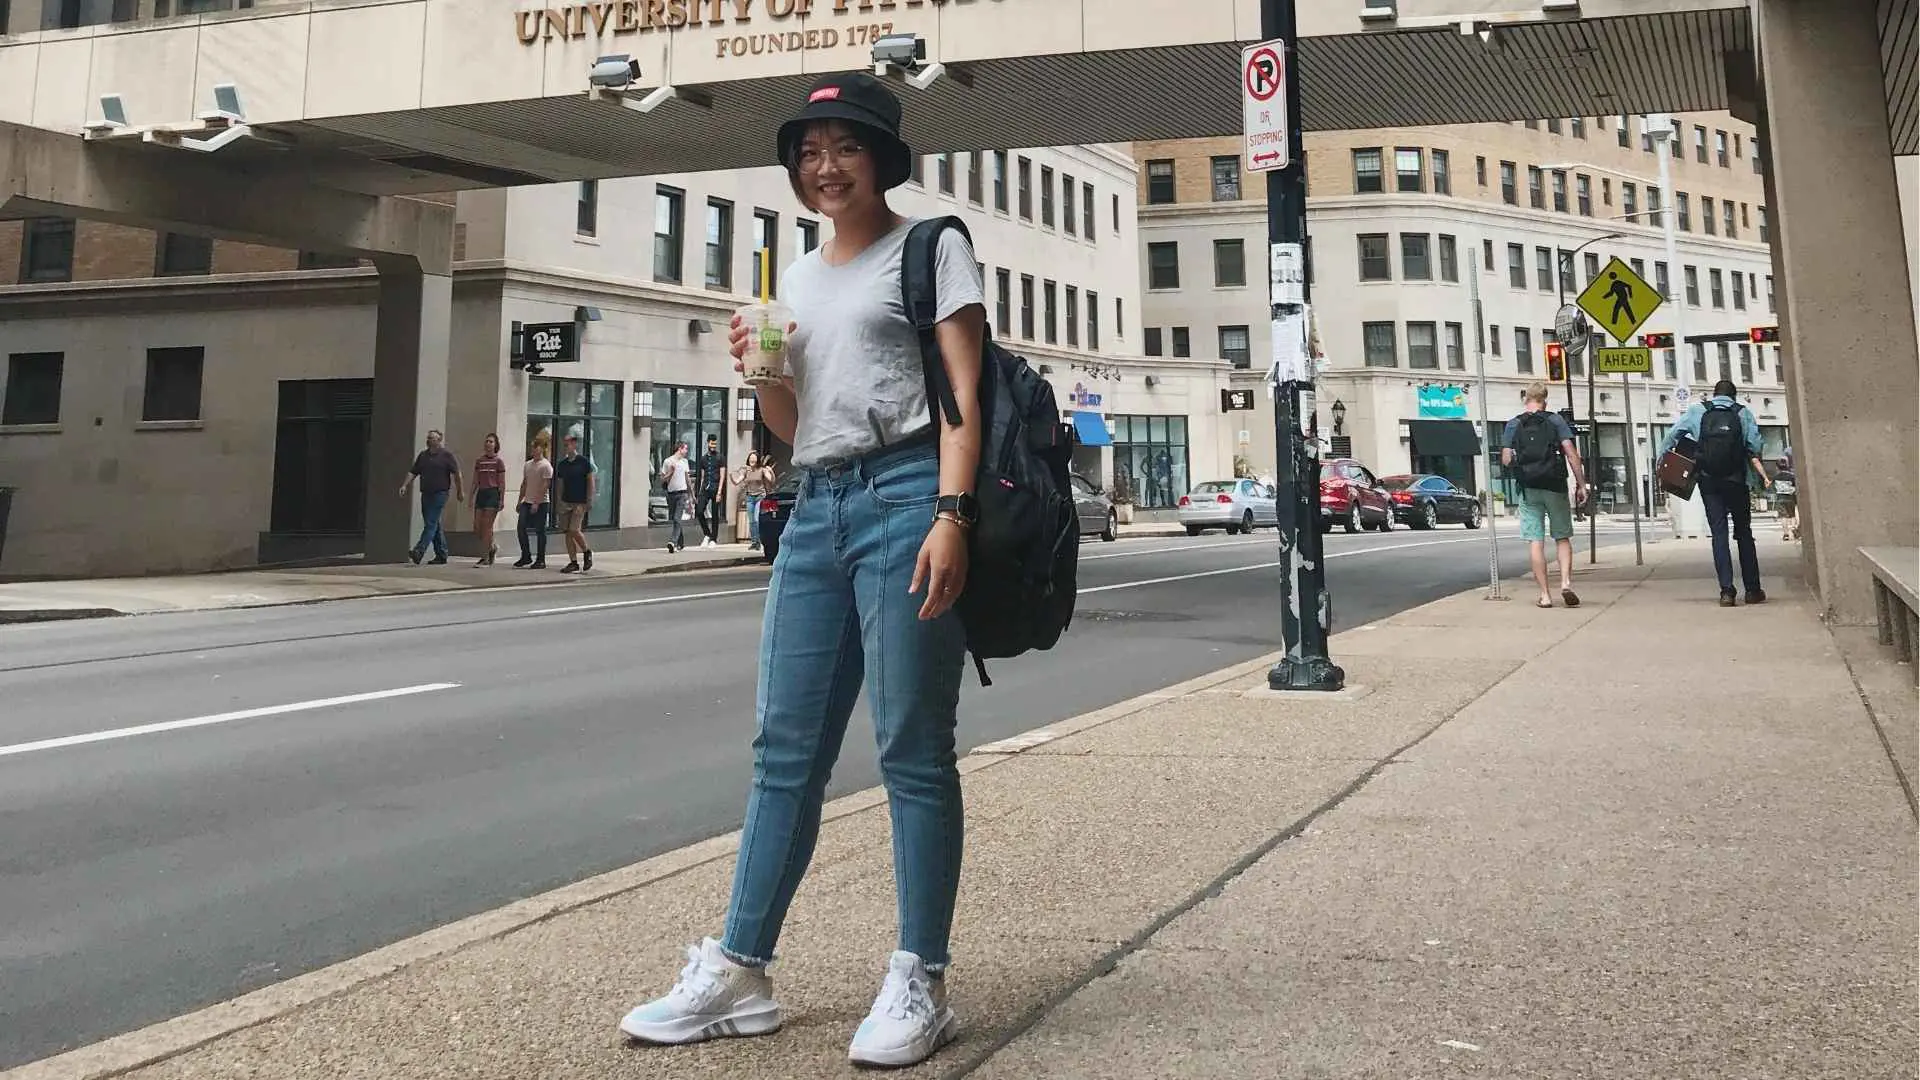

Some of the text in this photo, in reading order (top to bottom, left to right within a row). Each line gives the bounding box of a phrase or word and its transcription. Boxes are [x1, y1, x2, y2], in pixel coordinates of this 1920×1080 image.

[514, 0, 751, 46] UNIVERSITY
[716, 28, 839, 58] FOUNDED
[1259, 110, 1271, 125] OR
[1249, 131, 1283, 147] STOPPING
[532, 331, 562, 351] Pitt
[1604, 353, 1644, 366] AHEAD
